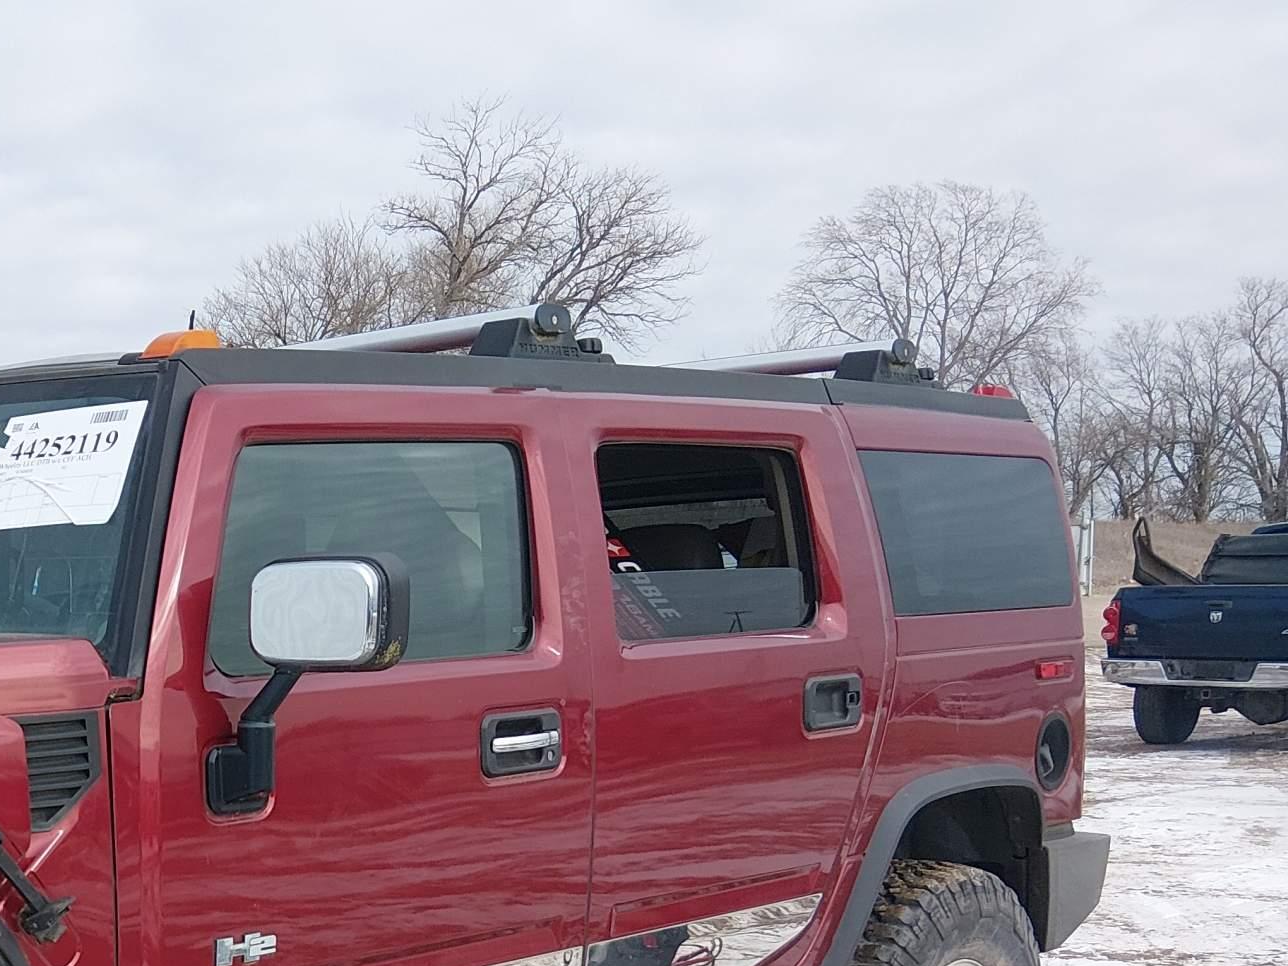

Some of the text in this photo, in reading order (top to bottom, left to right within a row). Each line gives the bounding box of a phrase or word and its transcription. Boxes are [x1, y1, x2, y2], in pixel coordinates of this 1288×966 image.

[520, 343, 579, 357] HUMMER
[11, 430, 118, 460] 44252119
[617, 560, 681, 621] CABLE
